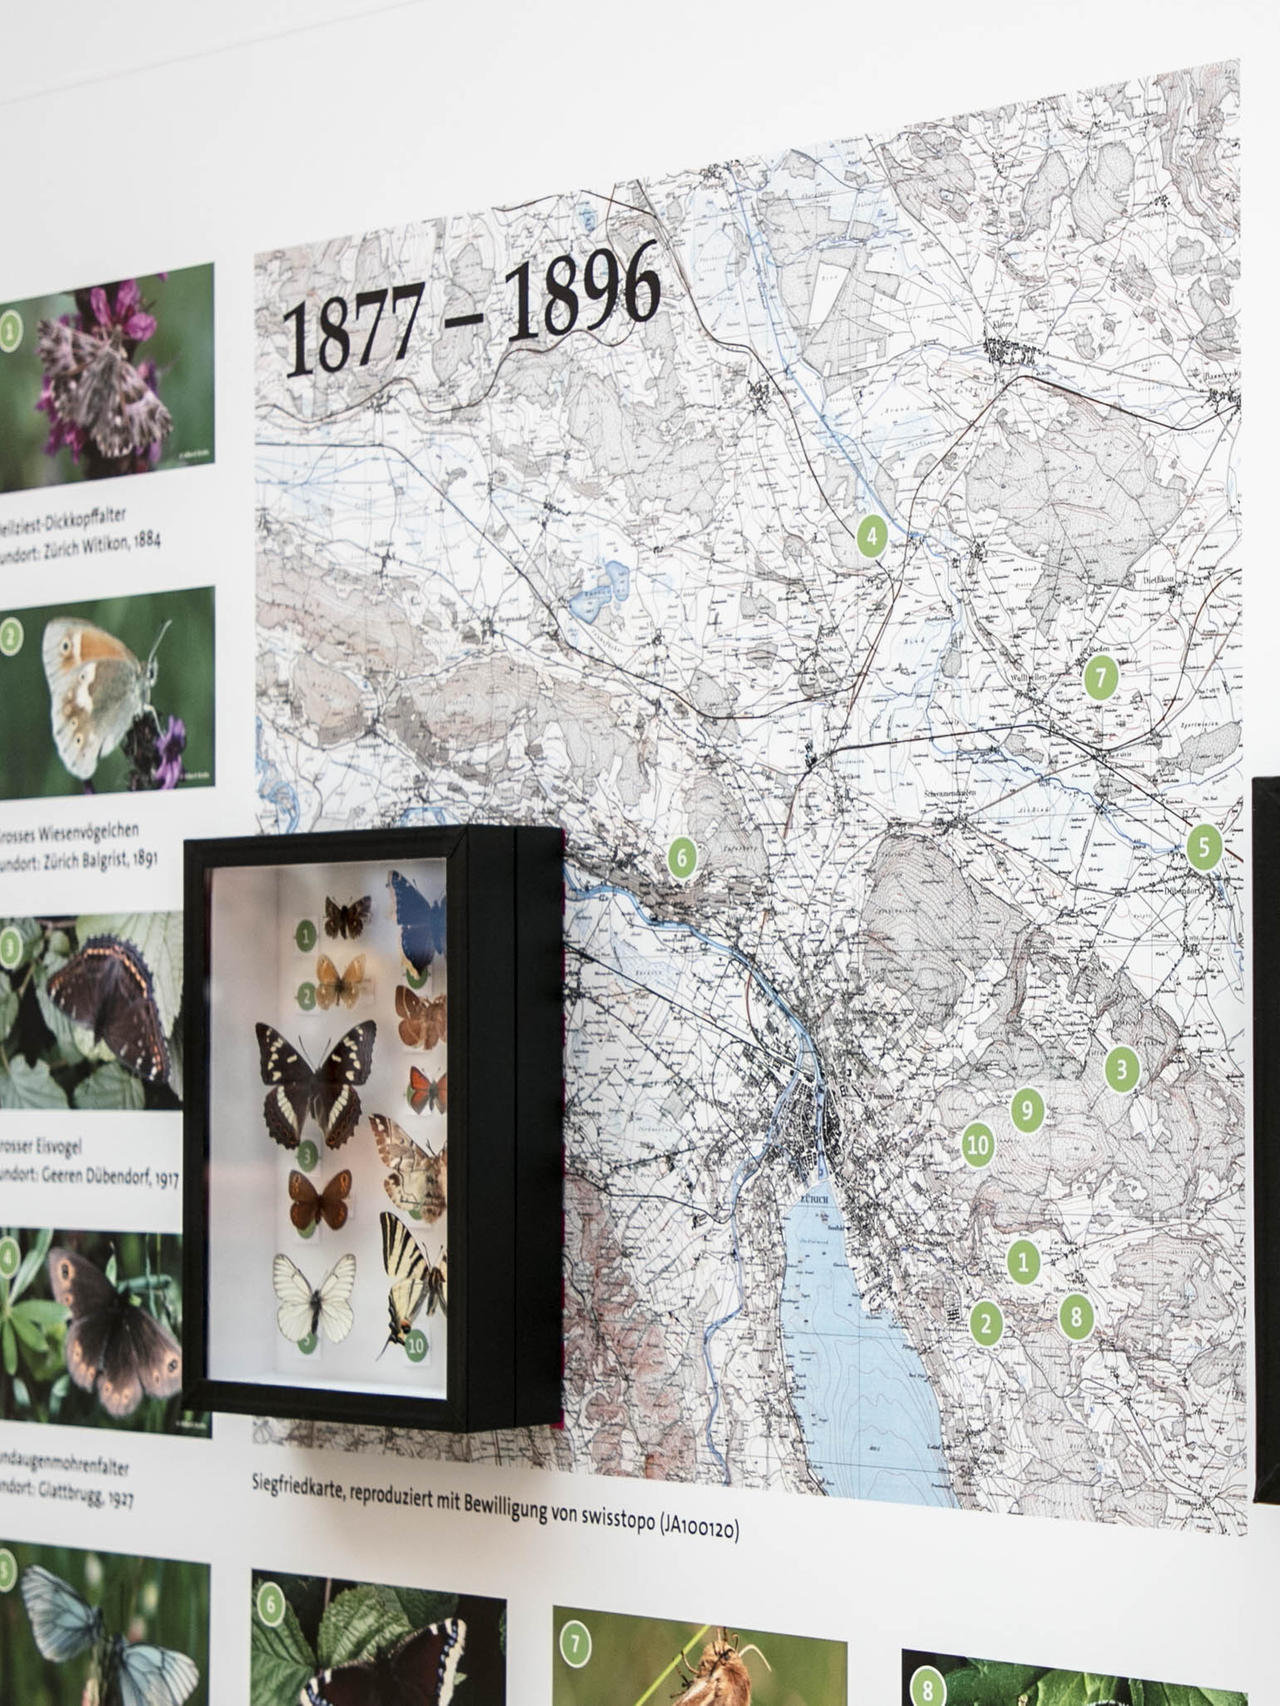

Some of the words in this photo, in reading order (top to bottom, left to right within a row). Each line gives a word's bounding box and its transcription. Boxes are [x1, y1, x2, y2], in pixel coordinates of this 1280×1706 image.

[283, 281, 426, 379] 1877
[505, 238, 661, 343] 1896
[0, 506, 127, 538] eilziest-Dickkopffalter
[866, 526, 878, 545] 4
[0, 545, 41, 565] undort:
[44, 541, 80, 561] Zürich
[82, 535, 131, 554] Witikon,
[134, 528, 162, 549] 1884
[1095, 667, 1107, 688] 7
[0, 829, 36, 846] rosses
[38, 821, 139, 843] Wiesenvögelchen
[1199, 836, 1210, 858] 5
[0, 854, 41, 872] undort:
[44, 852, 79, 870] Zürich
[83, 850, 130, 872] Balgrist,
[134, 848, 158, 870] 1891
[677, 848, 688, 868] 6
[303, 929, 310, 944] 1
[303, 989, 311, 1005] 2
[1117, 1059, 1128, 1080] 3
[1022, 1100, 1033, 1121] 9
[0, 1138, 33, 1154] rosser
[36, 1137, 82, 1160] Eisvogel
[967, 1135, 989, 1156] 10
[303, 1148, 311, 1165] 3
[42, 1166, 82, 1183] Geeren
[86, 1167, 152, 1189] Dübendorf,
[156, 1172, 179, 1190] 1917
[1018, 1252, 1029, 1273] 1
[981, 1313, 992, 1334] 2
[1071, 1306, 1083, 1328] 8
[408, 1338, 424, 1354] 10
[0, 1448, 129, 1477] ndaugenmohrenfalter
[38, 1480, 105, 1509] Glattbrugg,
[109, 1492, 134, 1510] 1927
[252, 1472, 346, 1503] Siegfriedkarte,
[350, 1484, 433, 1508] reproduziert
[437, 1490, 461, 1511] mit
[464, 1492, 548, 1525] Bewilligung
[551, 1506, 578, 1522] von
[582, 1506, 655, 1535] swisstopo
[660, 1511, 740, 1544] (JA100120)
[266, 1595, 276, 1614] 6
[571, 1634, 580, 1653] 7
[922, 1680, 934, 1702] 8
